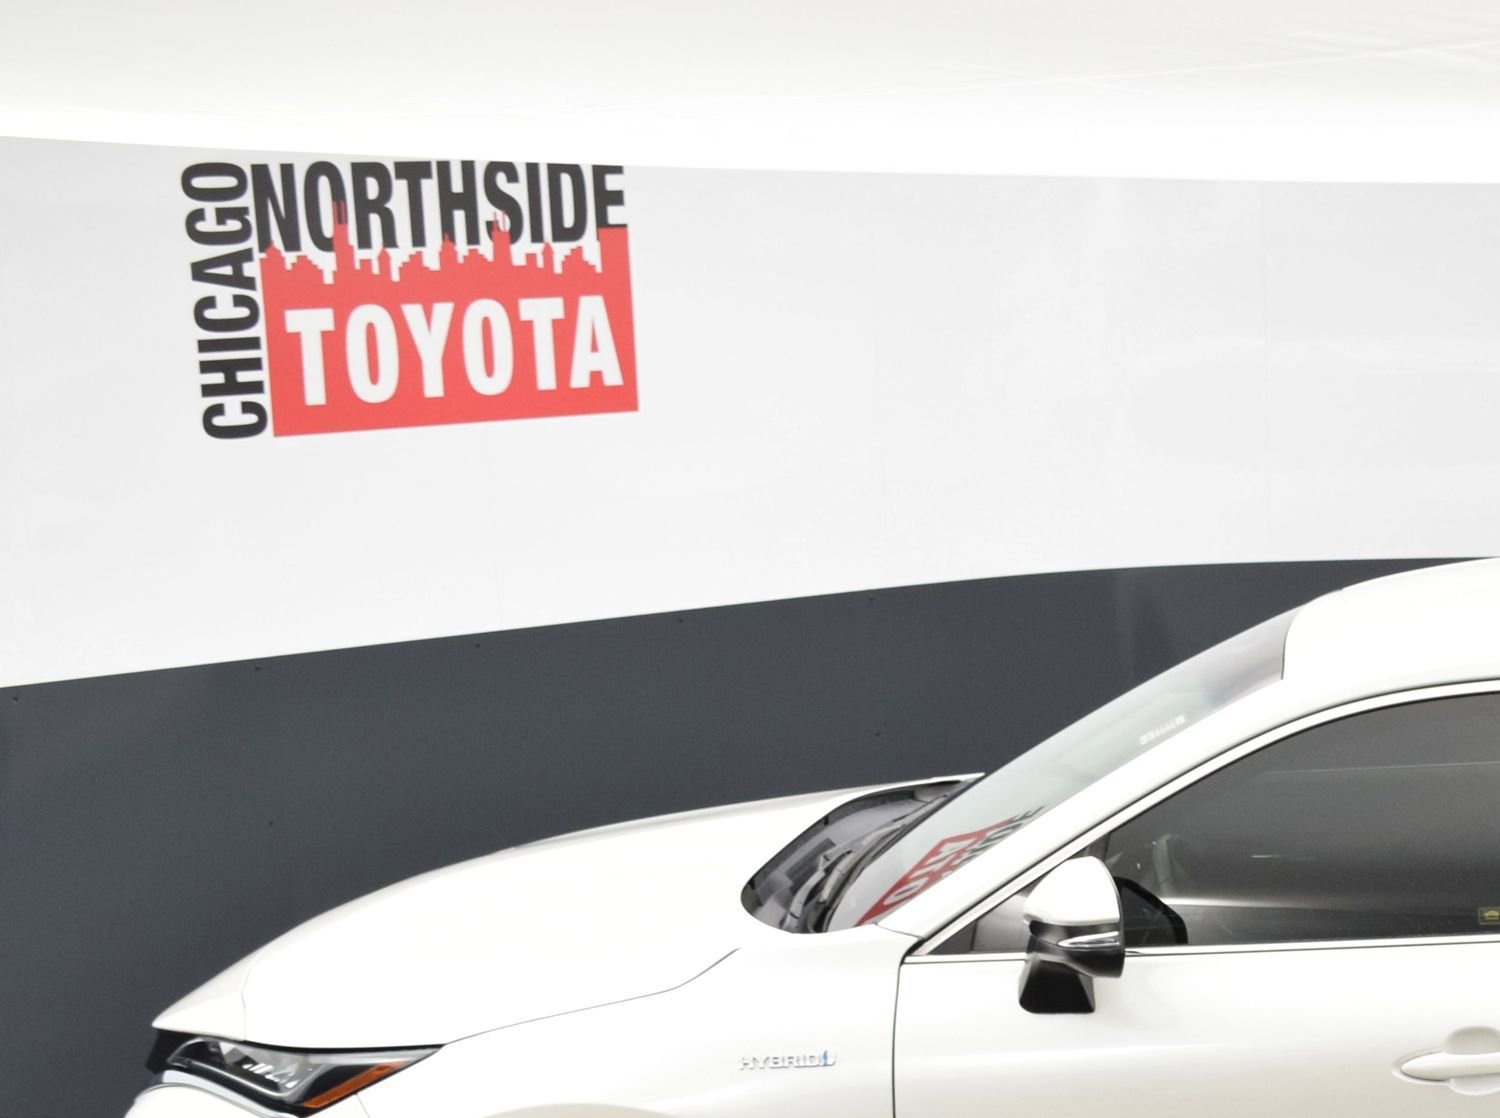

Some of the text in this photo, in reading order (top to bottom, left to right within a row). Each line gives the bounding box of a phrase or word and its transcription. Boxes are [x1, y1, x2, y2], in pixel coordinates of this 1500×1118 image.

[250, 159, 628, 253] NORTHSIDE
[181, 162, 268, 440] CHICAGO
[284, 295, 624, 406] TOYOTA
[739, 1053, 822, 1070] HYBRID
